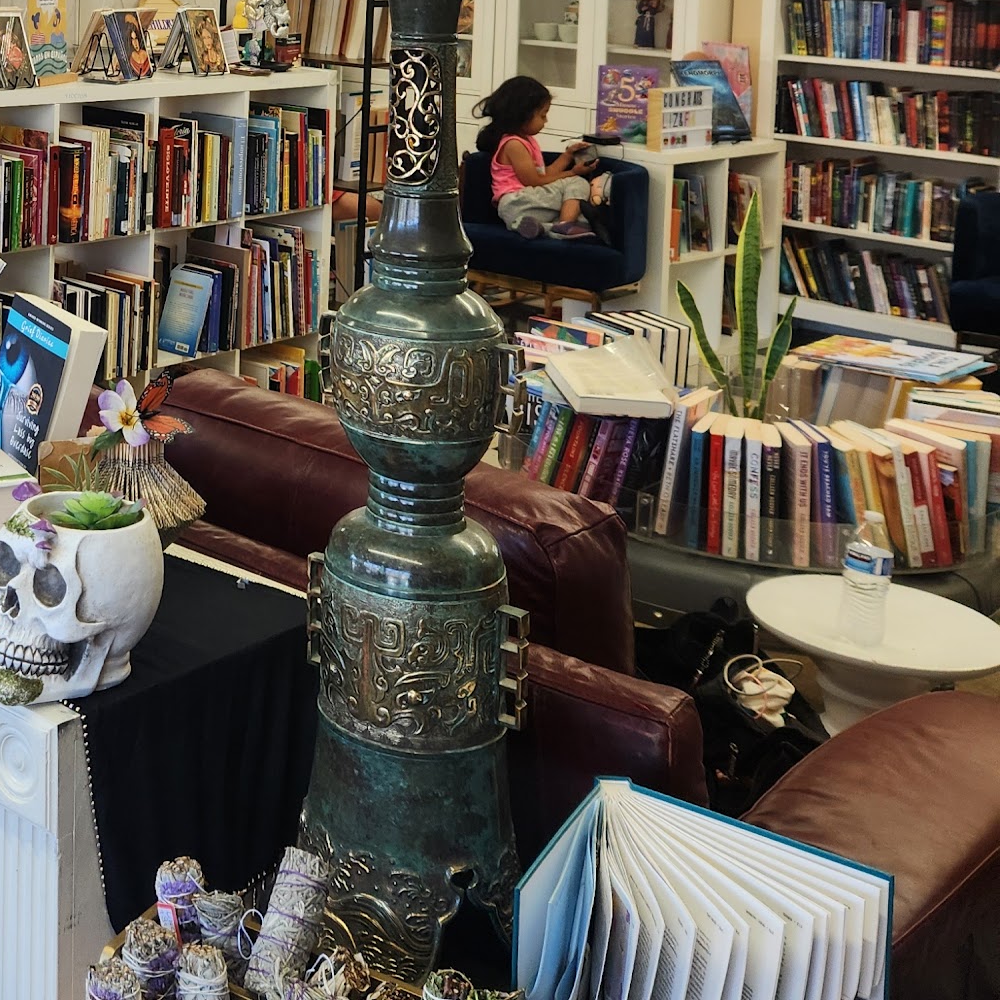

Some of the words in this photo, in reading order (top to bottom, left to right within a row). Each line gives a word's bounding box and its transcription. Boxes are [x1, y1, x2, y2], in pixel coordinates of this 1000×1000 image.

[617, 76, 636, 102] 5
[20, 320, 36, 337] Grief
[35, 330, 54, 348] Diaries
[16, 411, 40, 433] Surviving
[674, 409, 684, 424] THE
[9, 434, 33, 460] Overdose
[619, 445, 630, 467] ROSE
[668, 425, 682, 467] FLATSHARE
[729, 449, 740, 471] MAYBE
[799, 459, 808, 479] ENDS
[822, 449, 831, 473] YOU'VE
[728, 470, 738, 500] SOMEDAY
[749, 452, 759, 500] CONFESS
[768, 473, 777, 496] COLLEEN
[799, 479, 808, 498] WITH
[823, 474, 832, 503] REACHED
[768, 496, 777, 516] HOOVER
[799, 497, 808, 508] US
[824, 503, 833, 518] SAM
